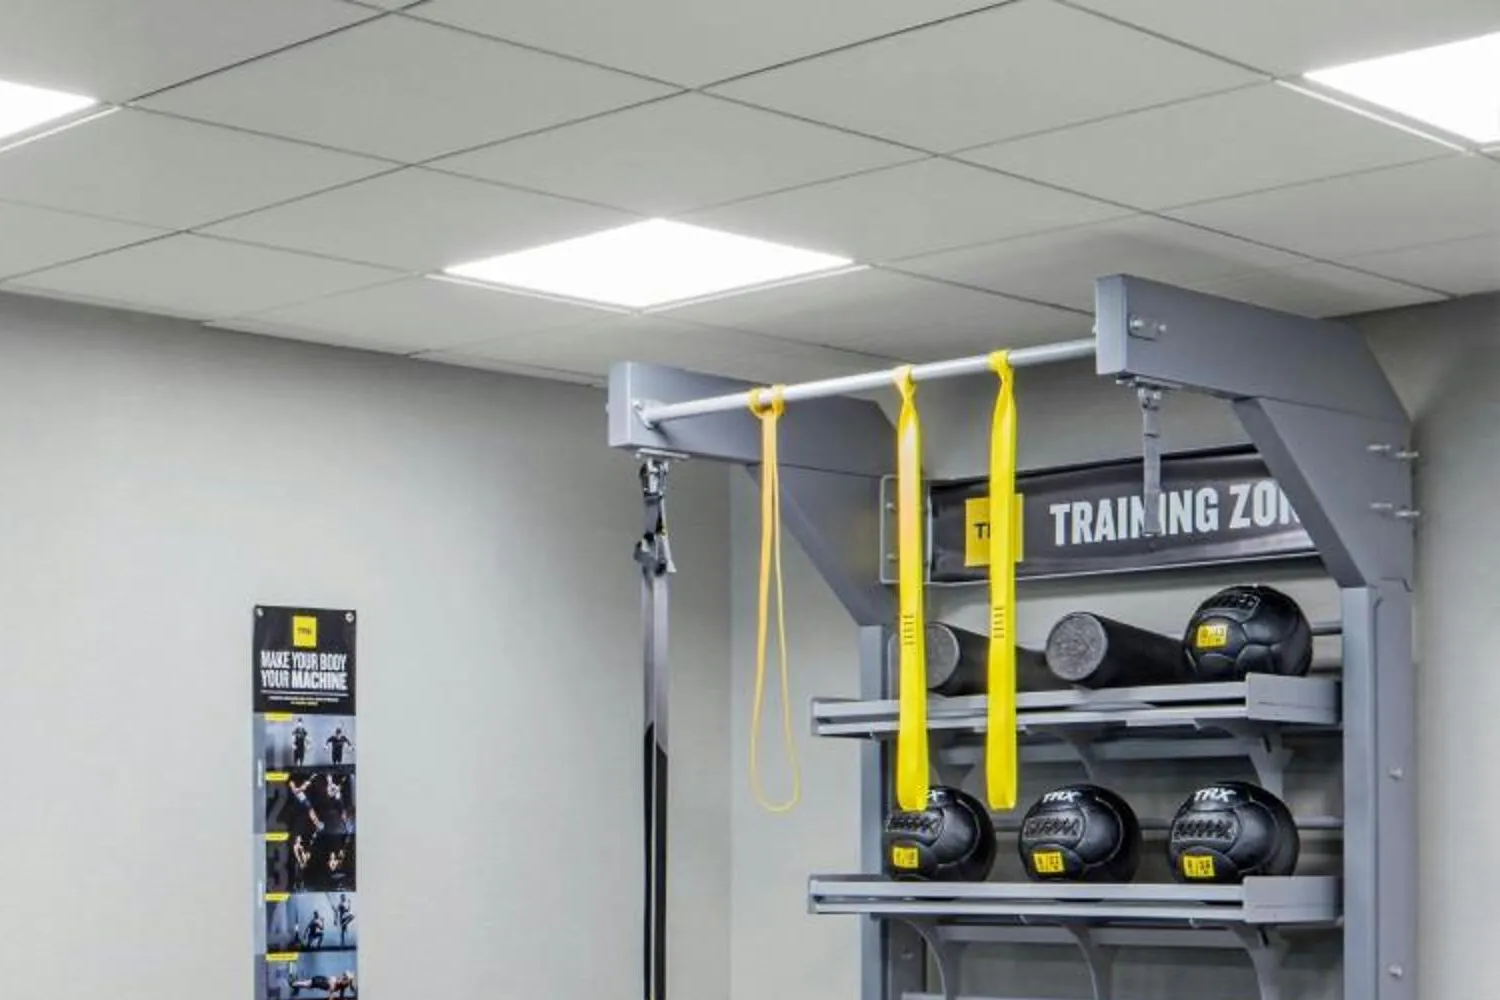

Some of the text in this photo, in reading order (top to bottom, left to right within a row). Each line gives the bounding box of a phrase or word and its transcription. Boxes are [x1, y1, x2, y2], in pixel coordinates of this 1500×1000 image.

[1050, 480, 1300, 546] TRAINING ZO
[260, 650, 347, 672] MAKE YOUR BODY
[260, 669, 348, 690] YOUR MACHINE
[1043, 790, 1082, 803] TRX
[1194, 787, 1237, 802] TRX
